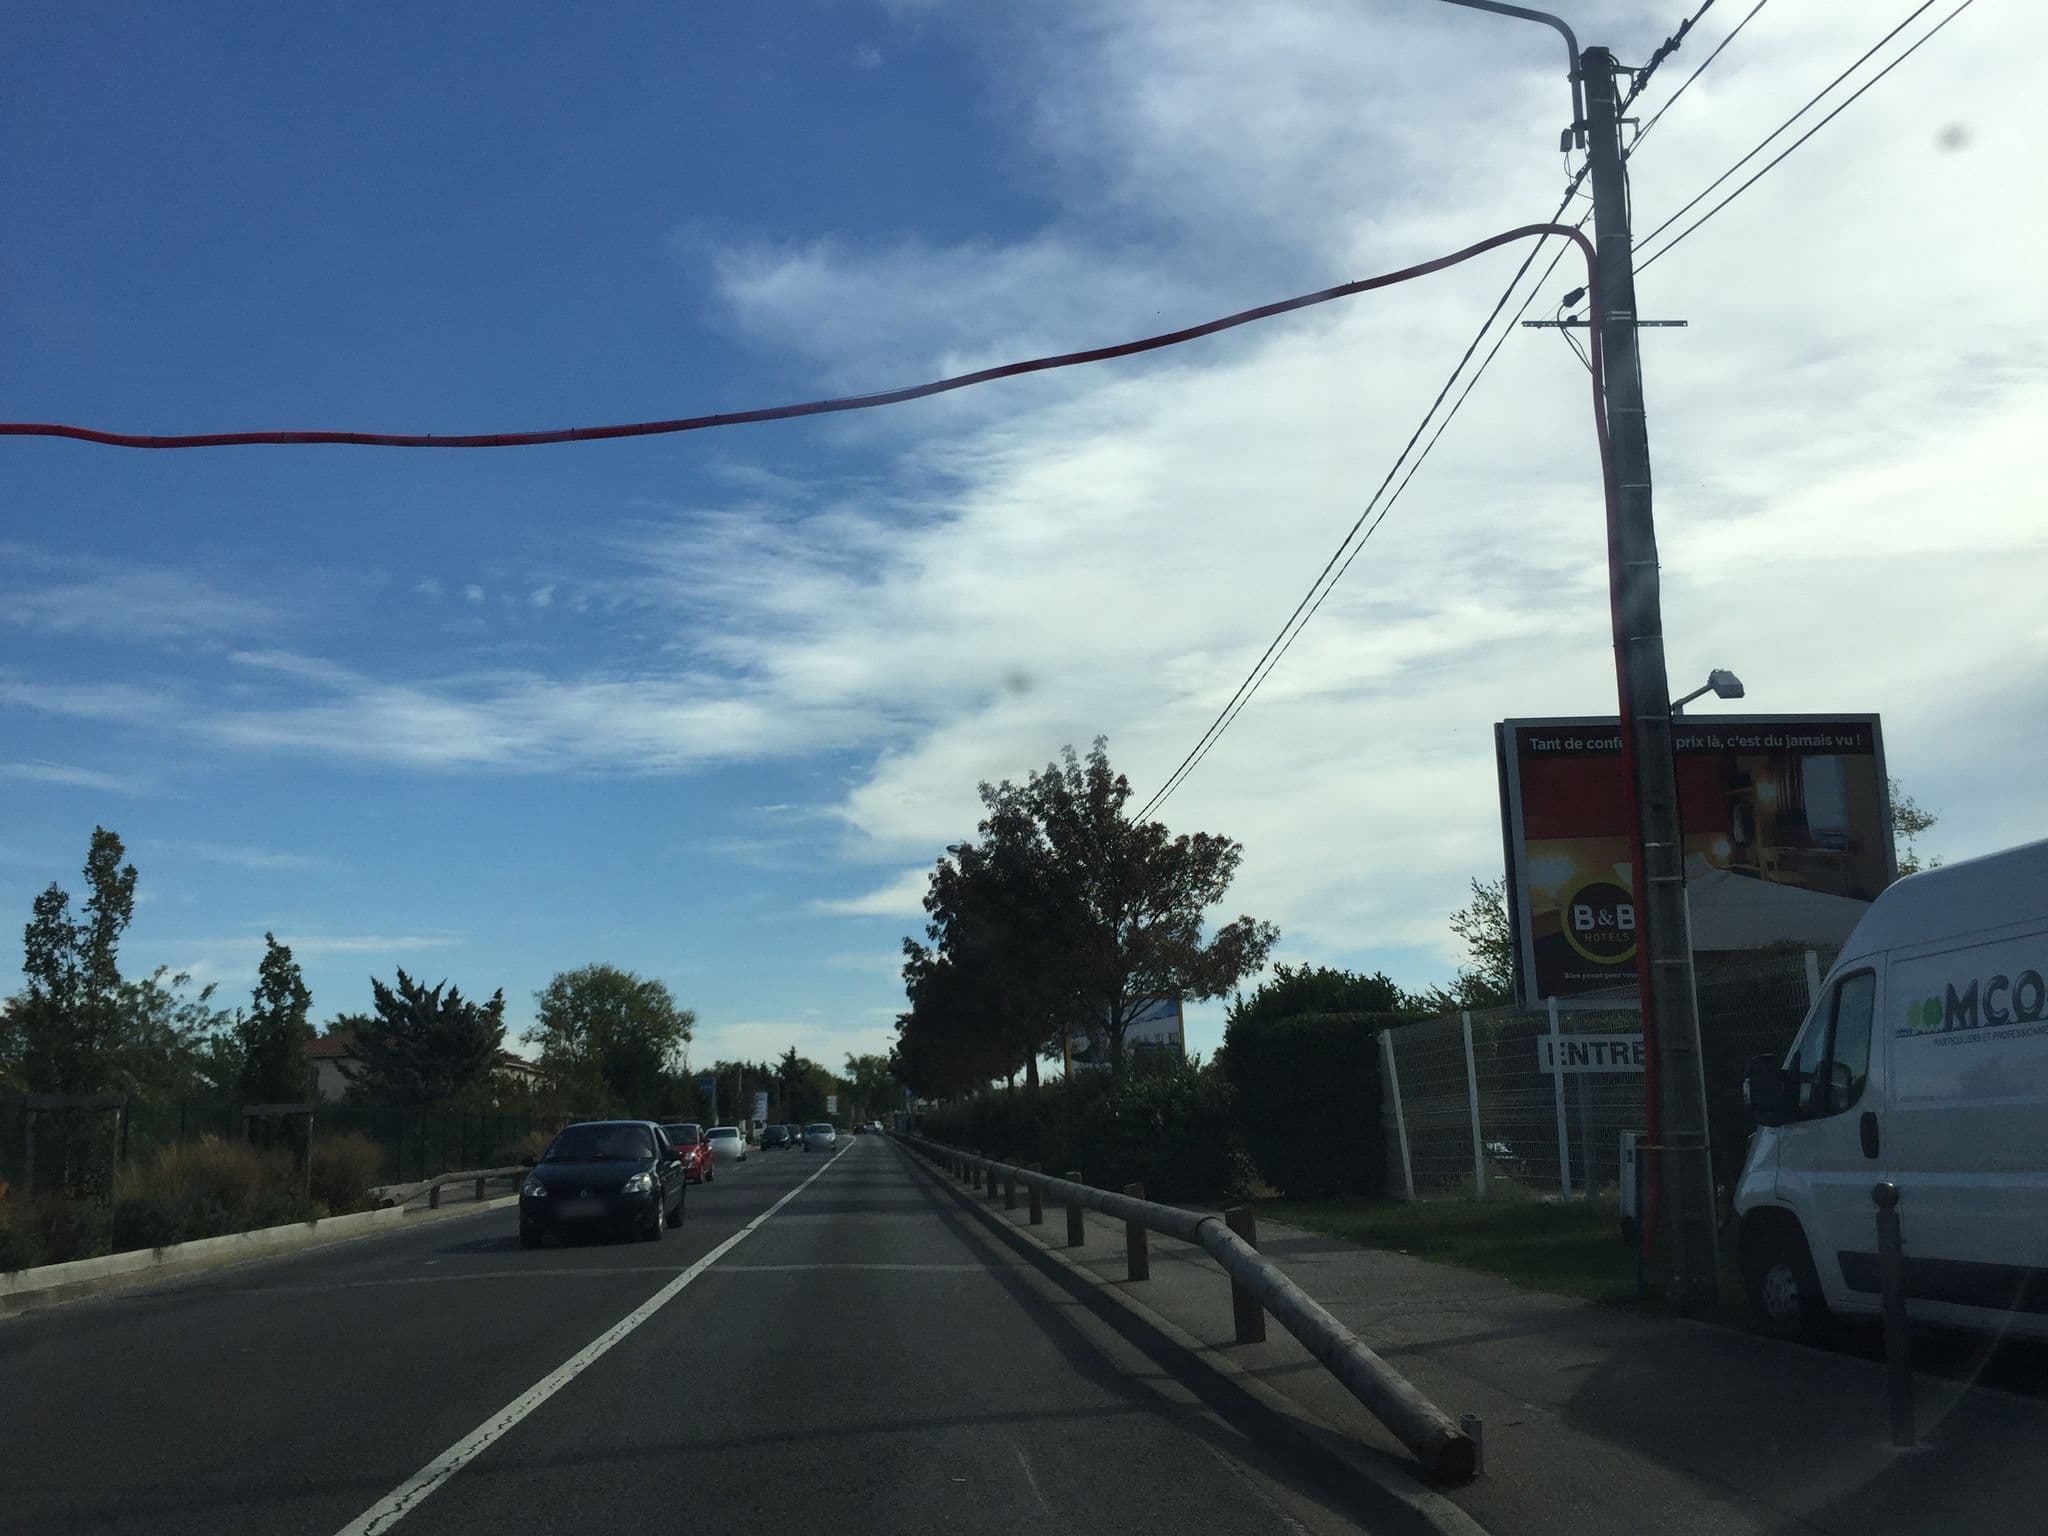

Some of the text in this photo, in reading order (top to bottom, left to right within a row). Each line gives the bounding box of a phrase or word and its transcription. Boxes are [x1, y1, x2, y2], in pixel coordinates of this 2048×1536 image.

[1529, 738, 1561, 750] Tant
[1565, 737, 1583, 749] de
[1676, 734, 1703, 750] prix
[1764, 735, 1782, 747] du
[1785, 734, 1832, 748] jamais
[1573, 904, 1636, 930] B&B
[1584, 933, 1630, 943] HOTELS
